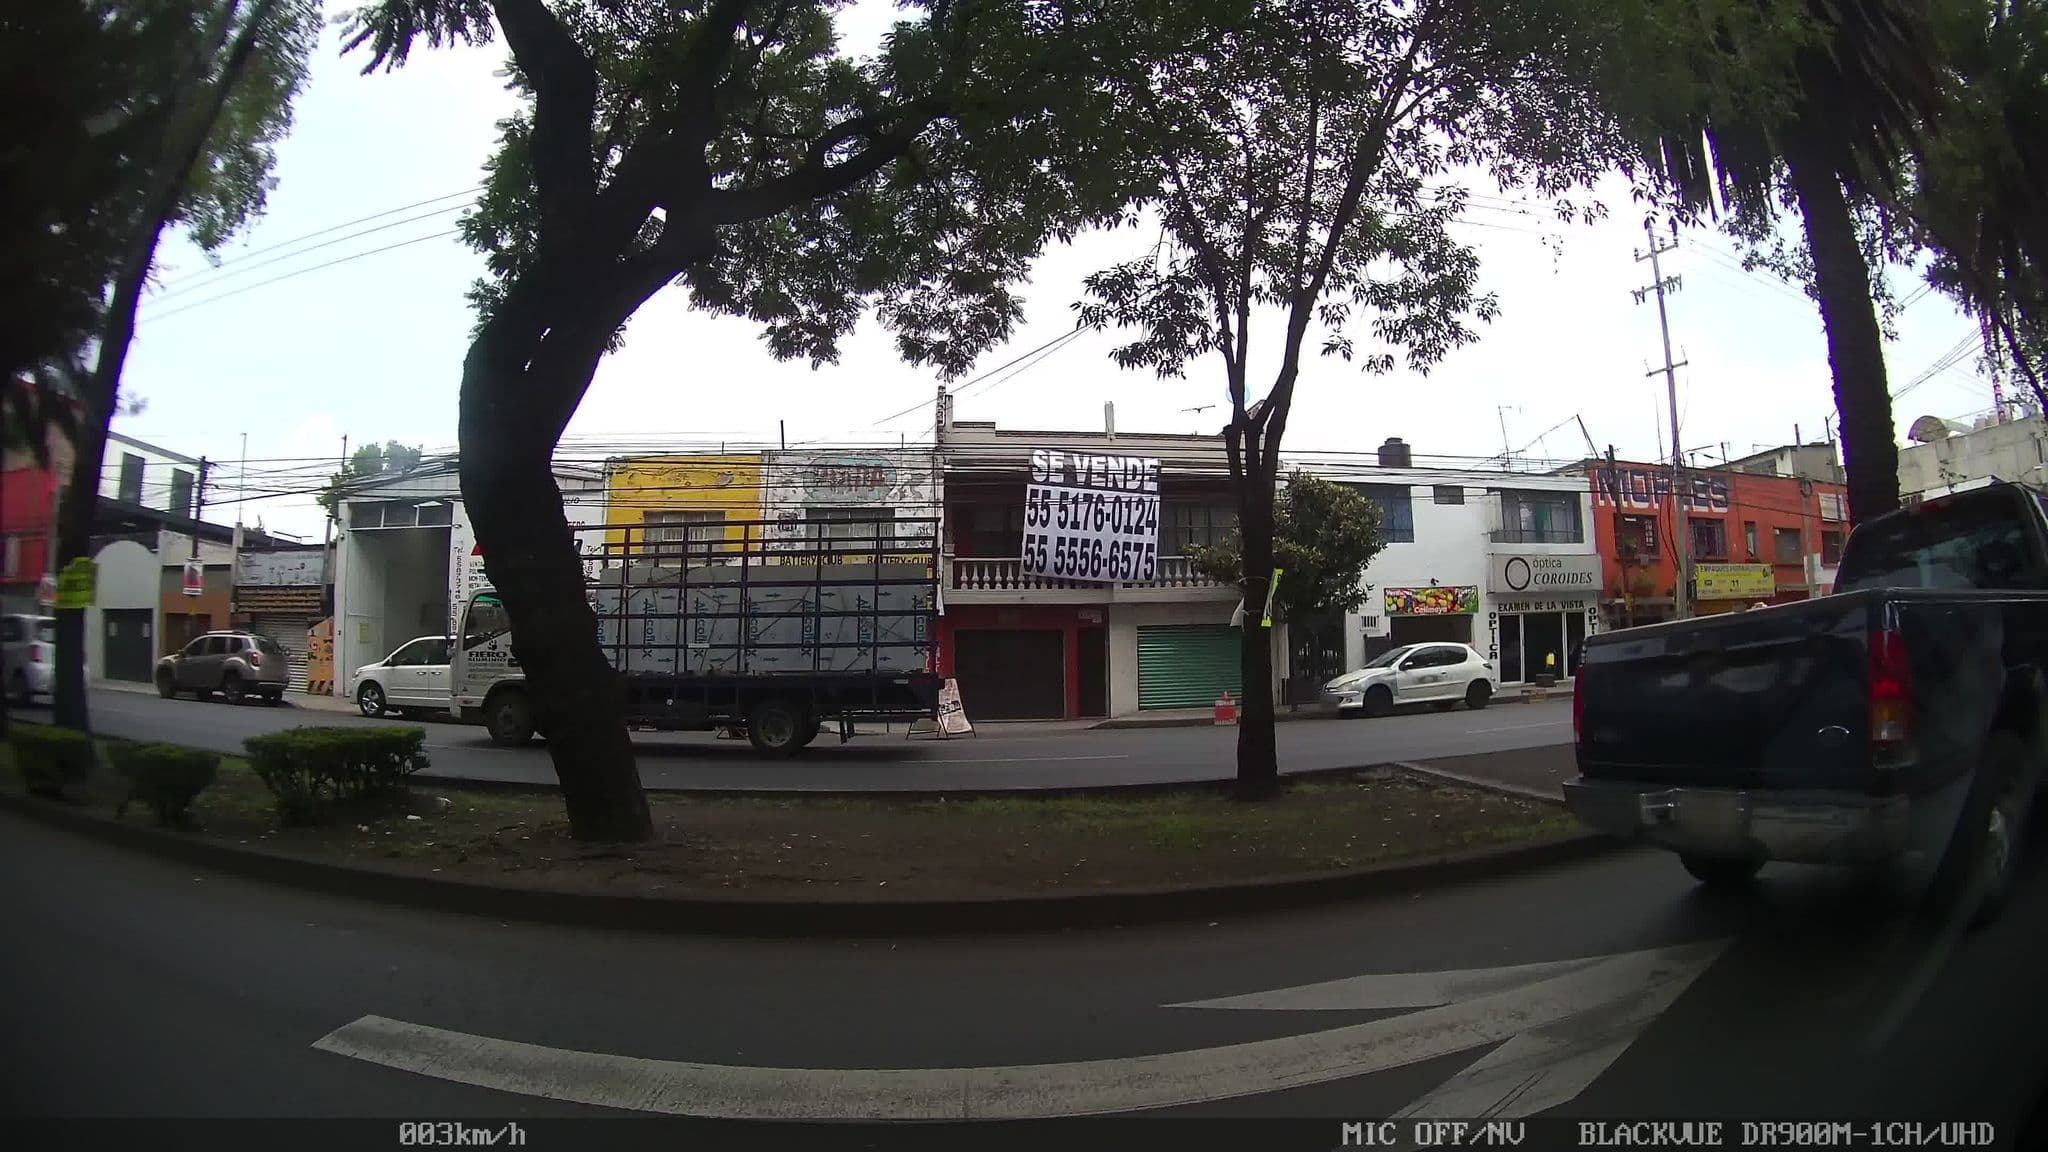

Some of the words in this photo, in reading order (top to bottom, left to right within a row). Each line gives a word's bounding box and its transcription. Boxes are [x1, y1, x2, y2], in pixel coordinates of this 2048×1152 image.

[1032, 449, 1065, 483] SE
[1072, 453, 1159, 491] VENDE
[1027, 489, 1051, 528] 55
[1057, 491, 1157, 536] 5176-0124
[1023, 534, 1048, 574] 55
[1053, 536, 1155, 581] 5556-6575
[1533, 572, 1593, 585] COROIDES
[1498, 602, 1530, 612] EXAMEN
[1534, 601, 1543, 610] DE
[1546, 600, 1557, 609] LA
[1561, 599, 1585, 609] VISTA
[1488, 611, 1498, 660] OPTICA
